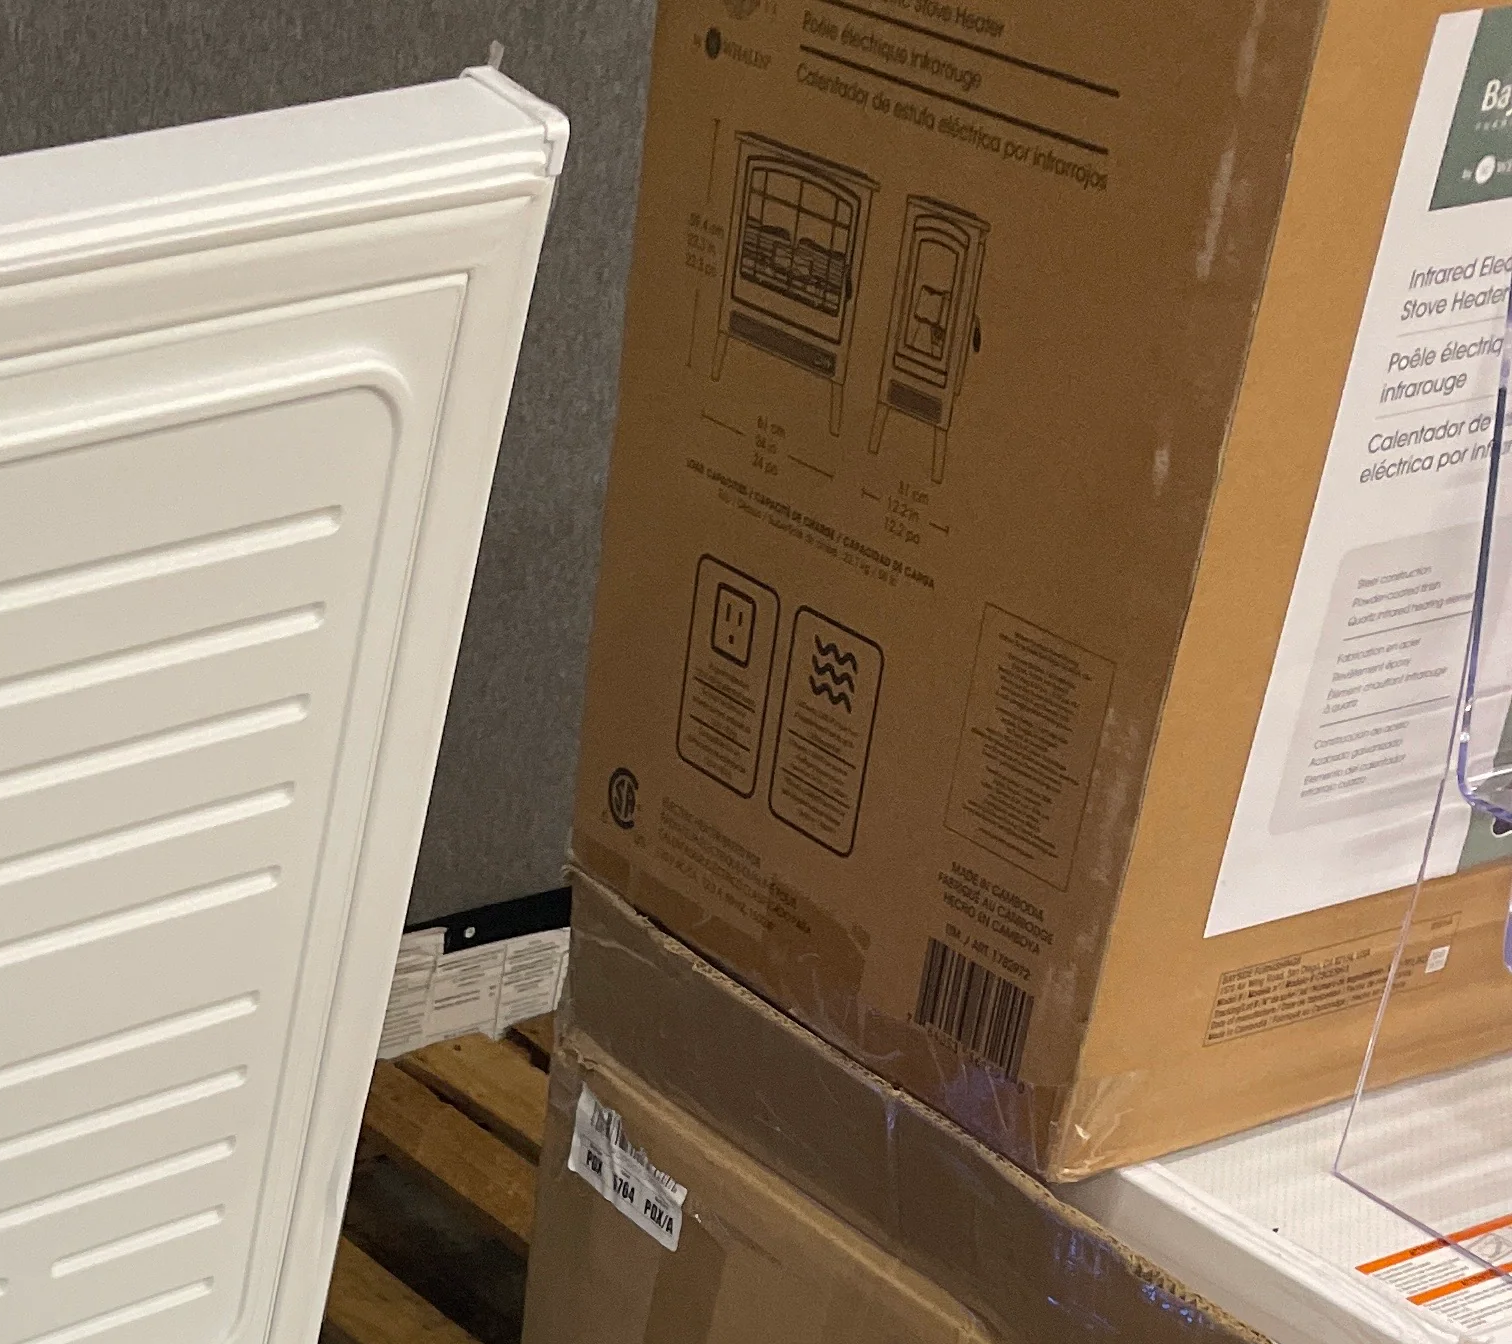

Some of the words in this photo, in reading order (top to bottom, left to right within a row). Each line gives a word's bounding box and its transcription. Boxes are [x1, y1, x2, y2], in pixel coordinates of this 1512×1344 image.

[871, 91, 890, 112] de
[1003, 139, 1030, 161] por
[1408, 258, 1477, 290] Infrared
[1400, 298, 1448, 321] Stove
[1450, 284, 1509, 312] Heater
[1387, 347, 1436, 373] Poêle
[1440, 336, 1505, 364] électriq
[1379, 372, 1468, 404] infrarouge
[1368, 420, 1465, 454] Calentador
[1468, 413, 1491, 433] de
[1359, 454, 1435, 484] eléctrica
[1436, 446, 1468, 472] por
